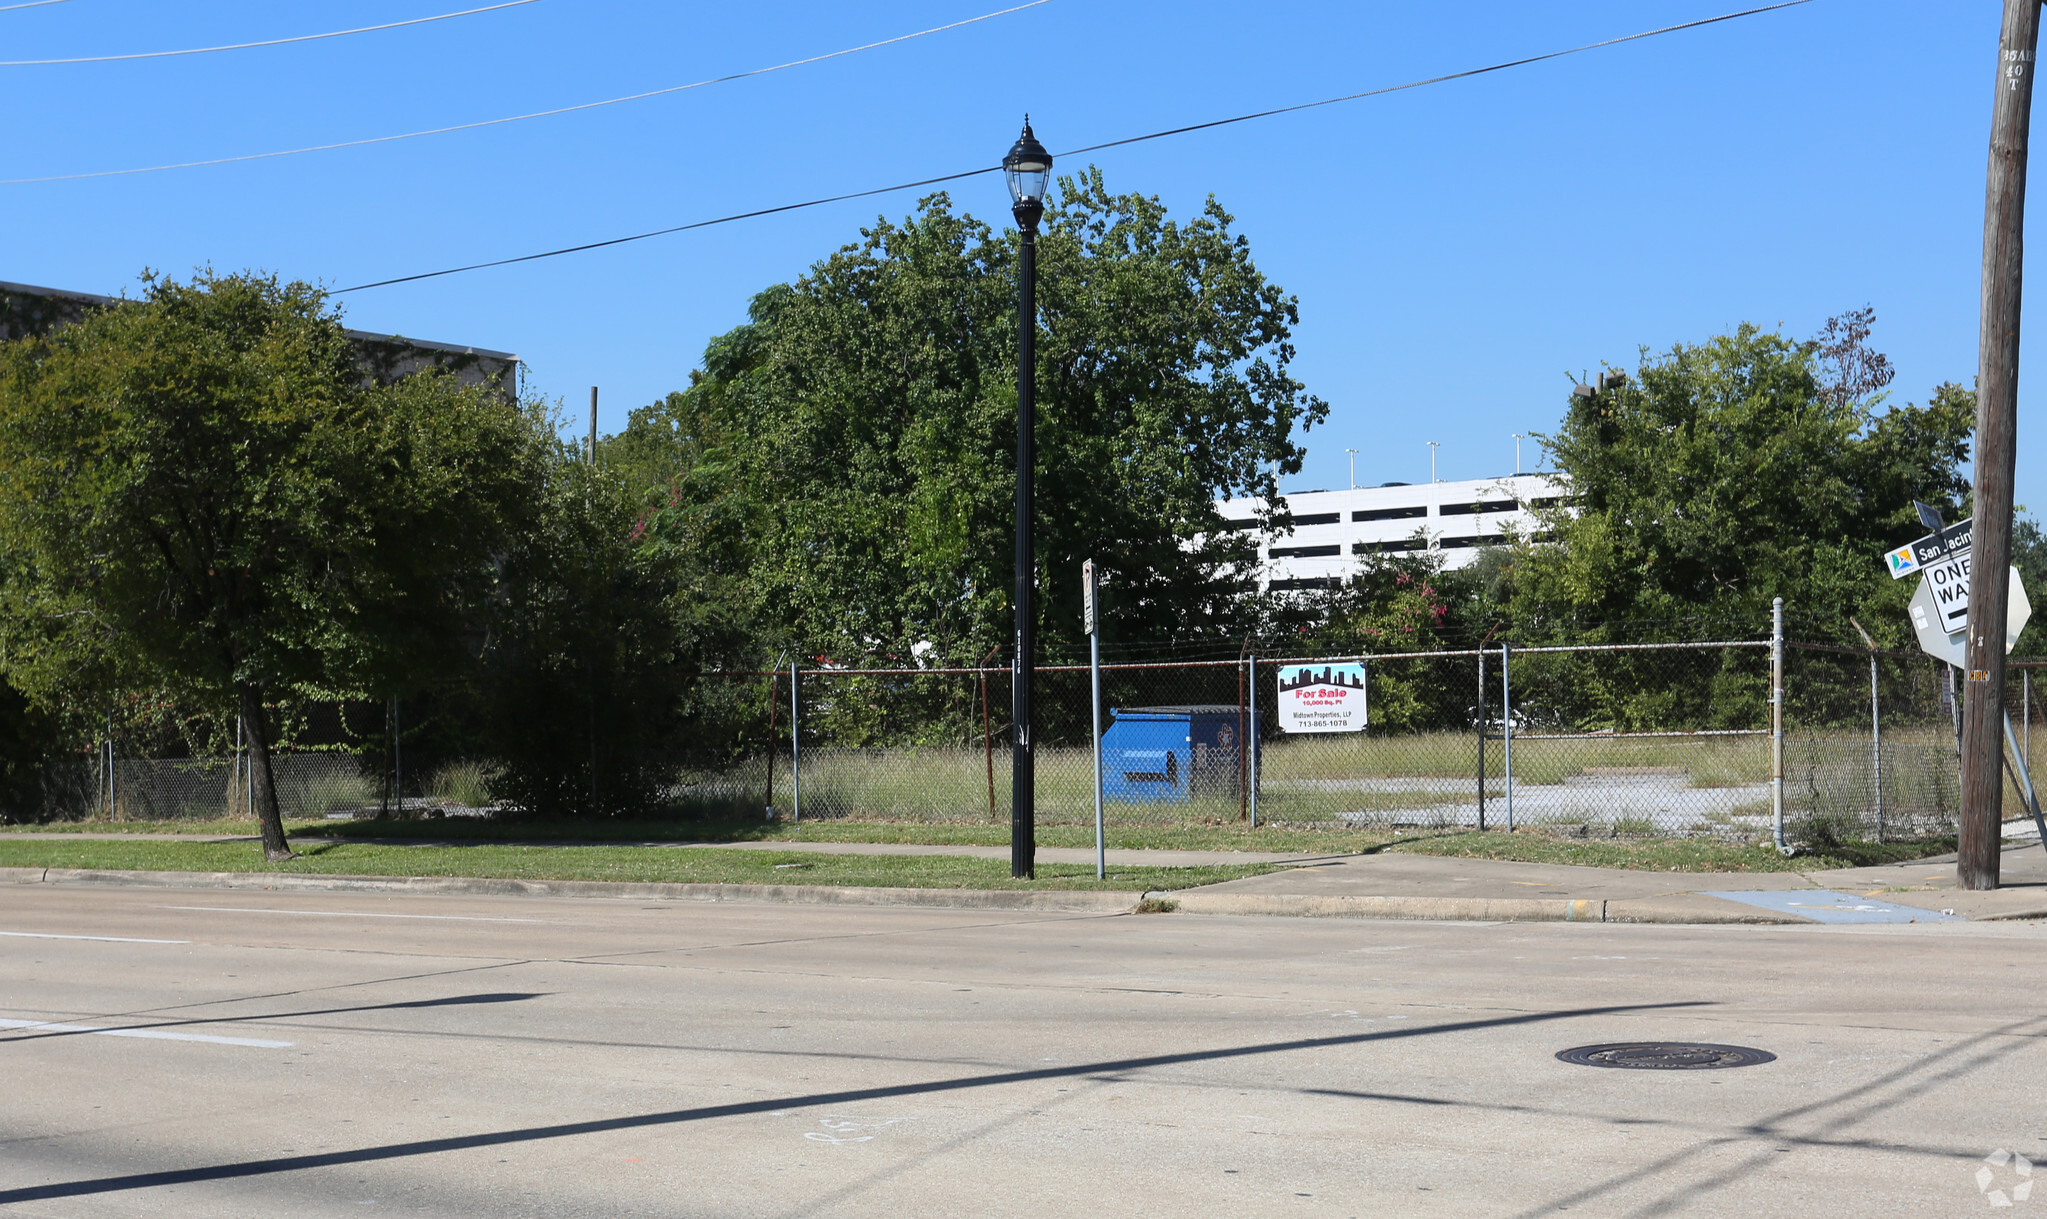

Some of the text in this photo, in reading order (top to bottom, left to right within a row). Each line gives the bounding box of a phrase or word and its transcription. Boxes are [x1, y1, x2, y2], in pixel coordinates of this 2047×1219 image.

[2005, 64, 2024, 78] 40
[2009, 78, 2019, 91] T
[1918, 545, 1941, 561] San
[1933, 558, 1971, 585] ONE
[1937, 579, 1970, 605] WA
[1295, 688, 1347, 699] For Sale
